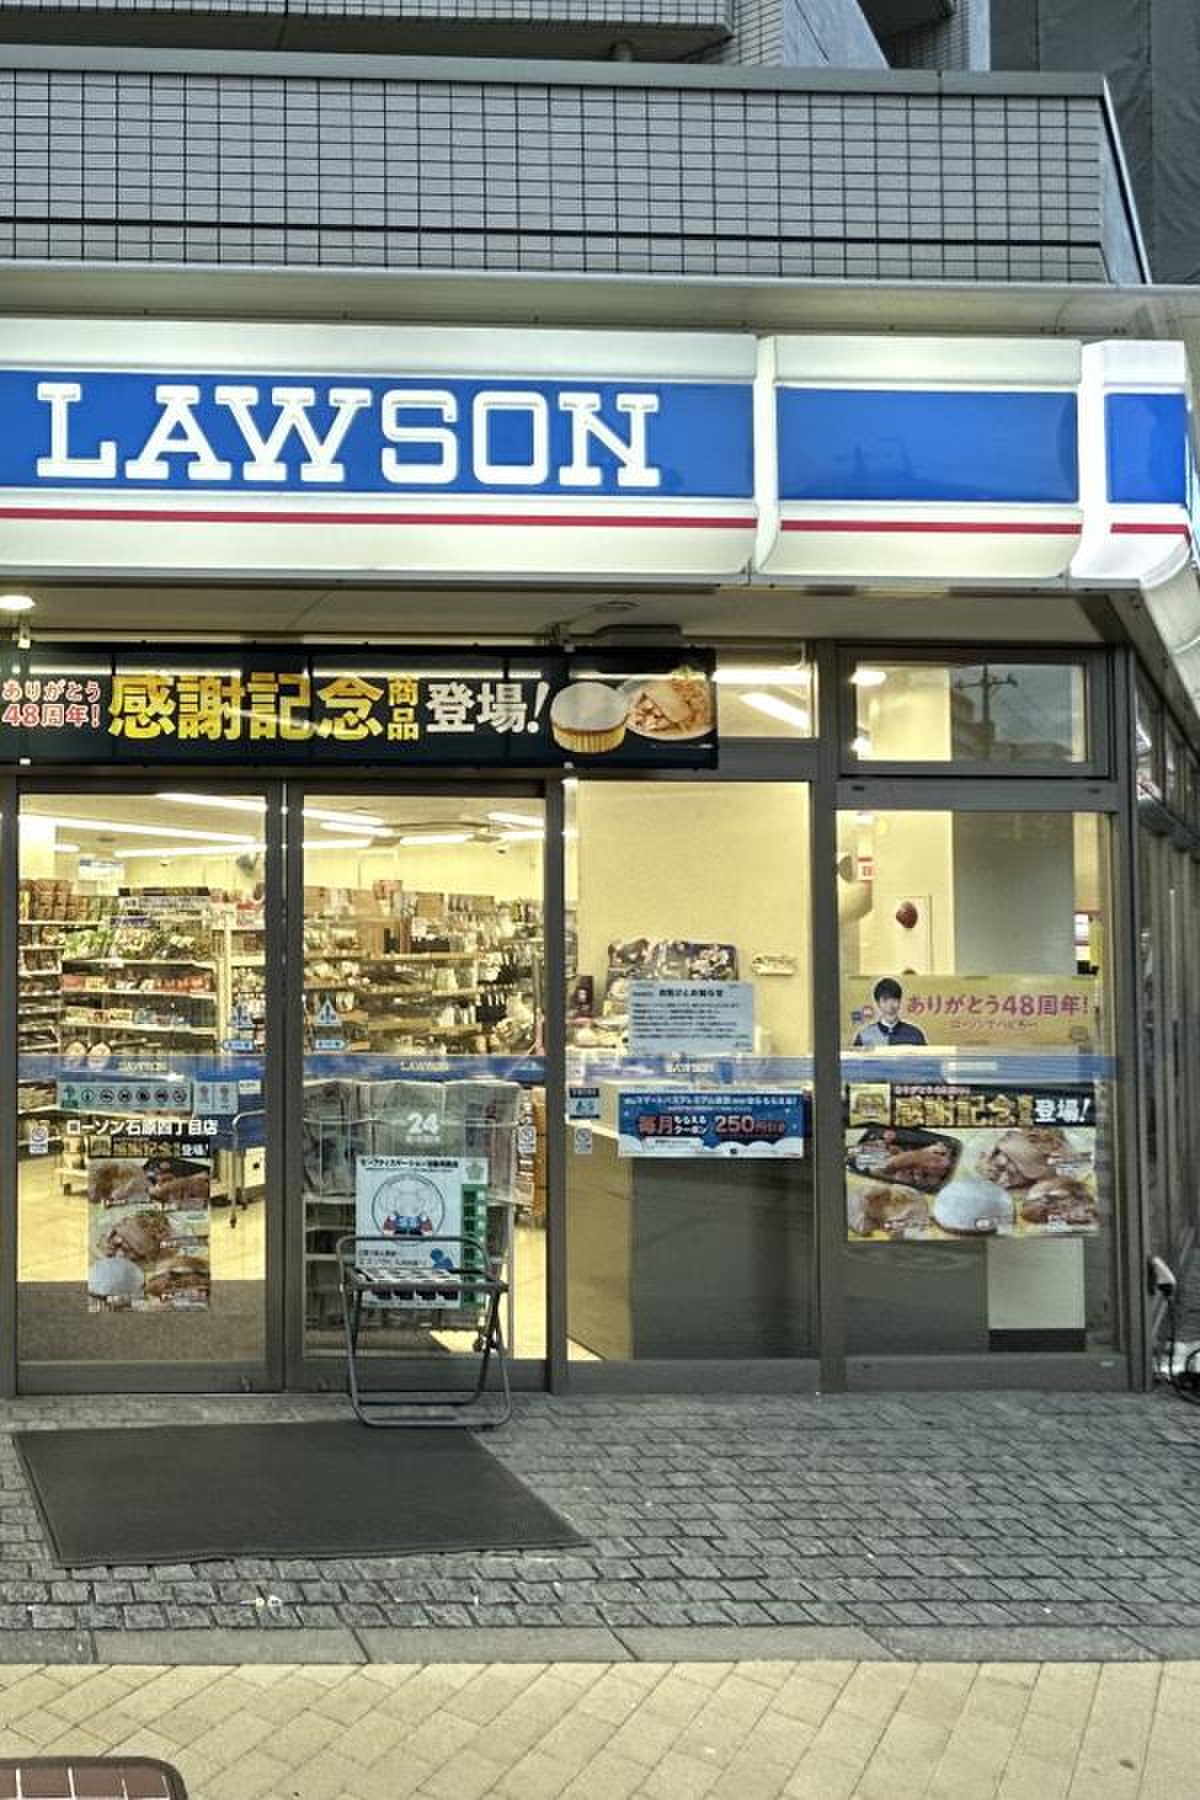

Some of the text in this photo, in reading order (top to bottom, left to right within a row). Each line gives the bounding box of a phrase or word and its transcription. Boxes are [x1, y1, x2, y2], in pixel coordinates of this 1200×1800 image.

[35, 382, 661, 489] LAWSON
[1, 680, 101, 702] ありがとう
[1, 703, 101, 728] 48周年!
[109, 672, 384, 740] 感謝記念
[425, 681, 550, 734] 登場!
[907, 994, 1089, 1017] ありがとう48周年!
[406, 1111, 439, 1134] 24
